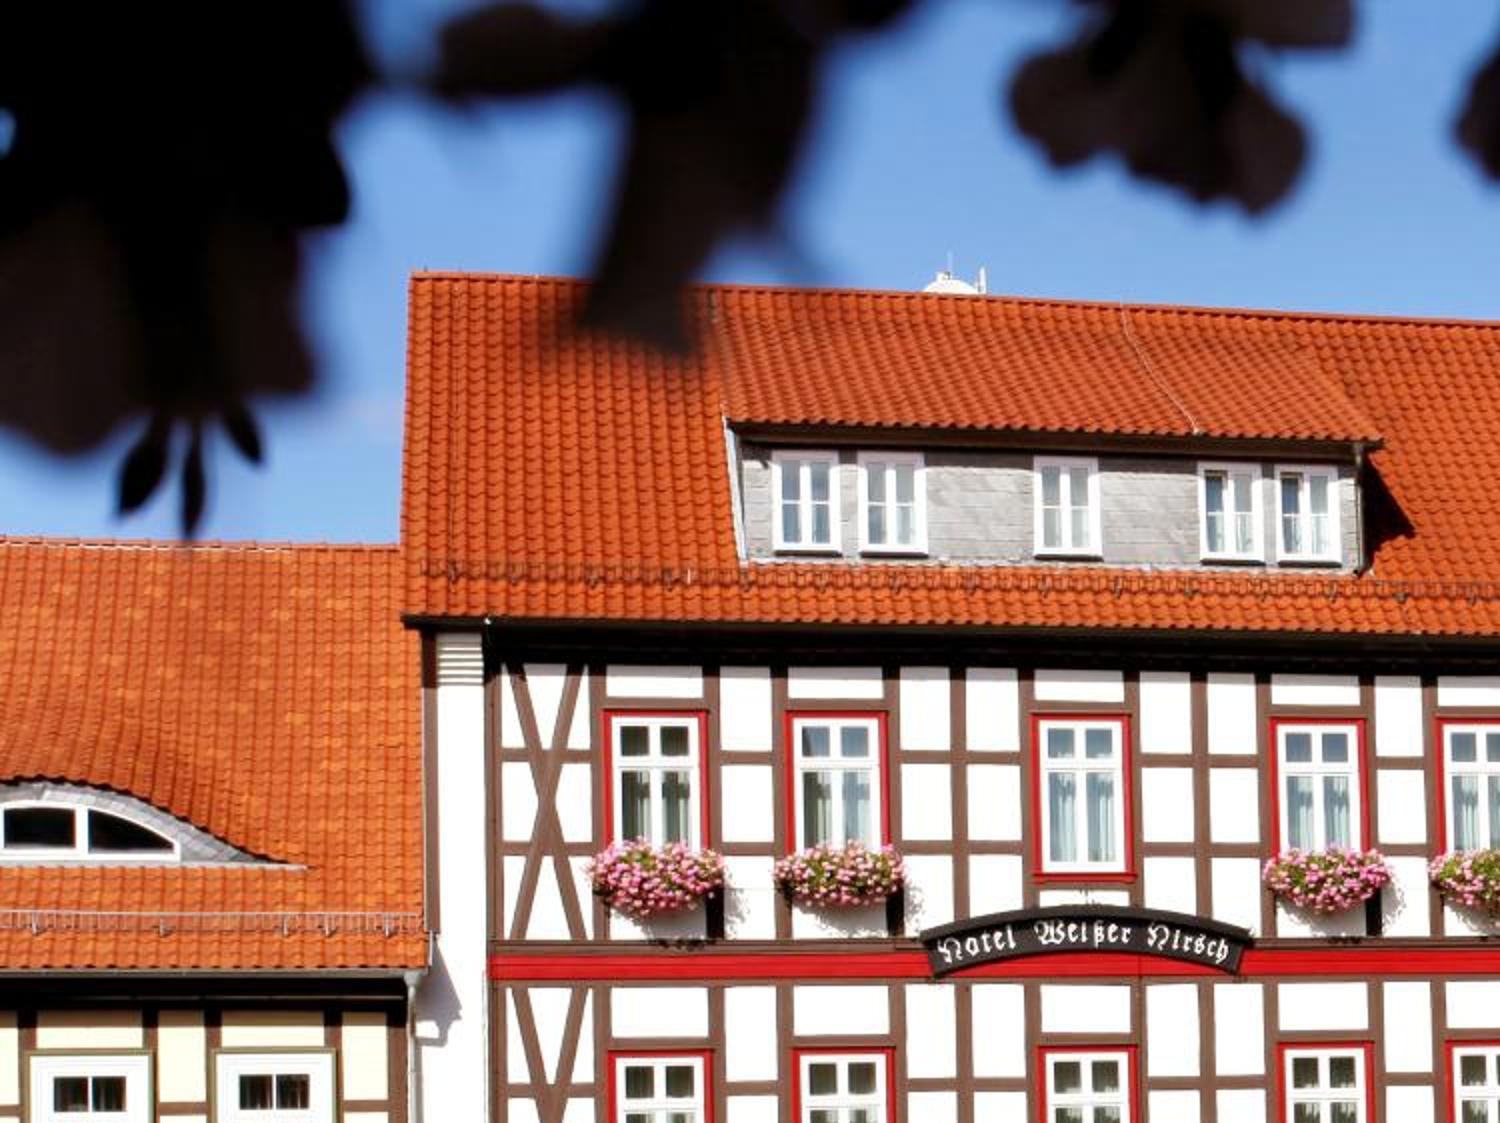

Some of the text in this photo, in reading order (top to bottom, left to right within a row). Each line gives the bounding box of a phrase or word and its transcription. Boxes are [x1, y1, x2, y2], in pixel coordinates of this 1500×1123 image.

[937, 919, 1230, 964] Hotel Weißer Hirsch
